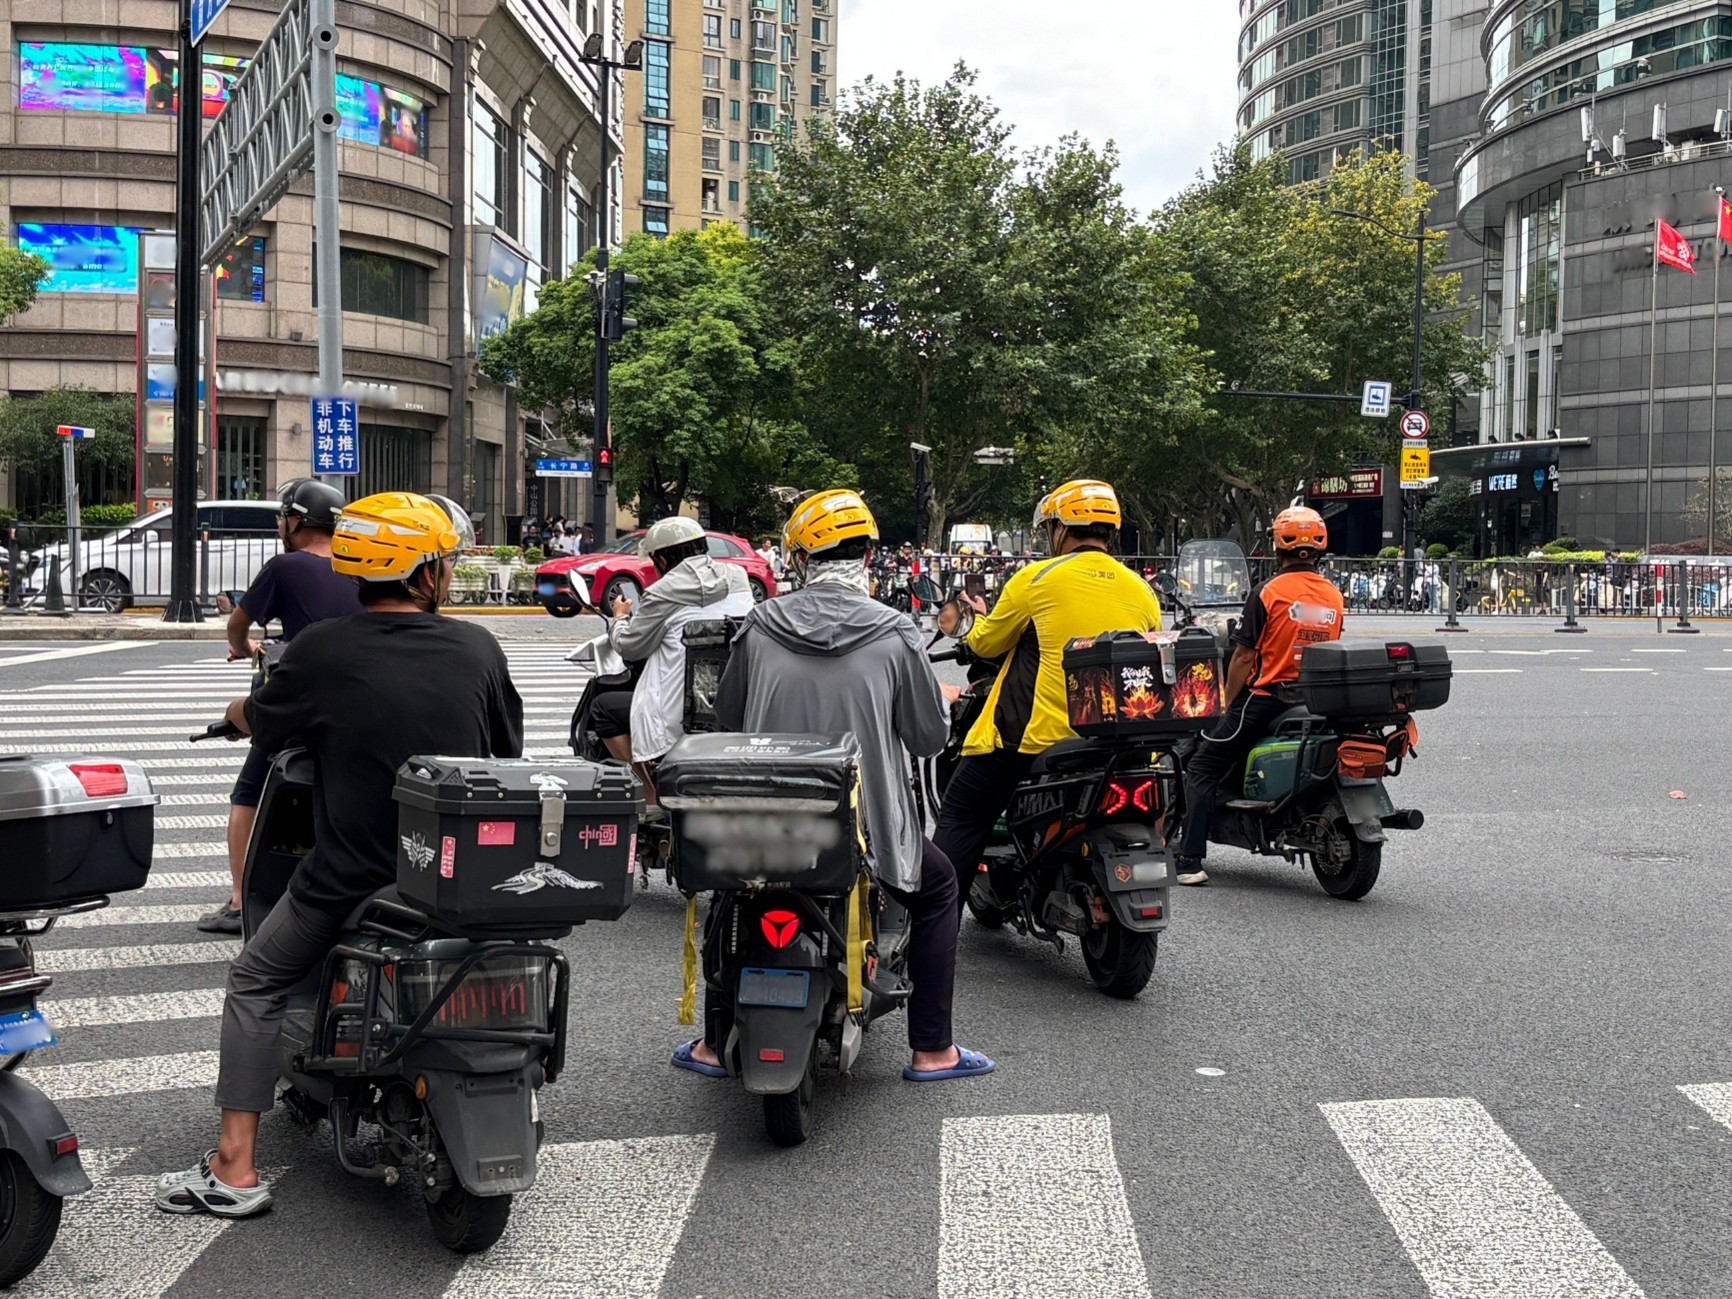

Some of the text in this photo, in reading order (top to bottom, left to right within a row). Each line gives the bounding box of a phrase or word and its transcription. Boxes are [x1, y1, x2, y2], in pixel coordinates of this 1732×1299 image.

[317, 402, 334, 469] 非机动车
[337, 401, 354, 469] 下车推行
[550, 462, 578, 470] 长宁路
